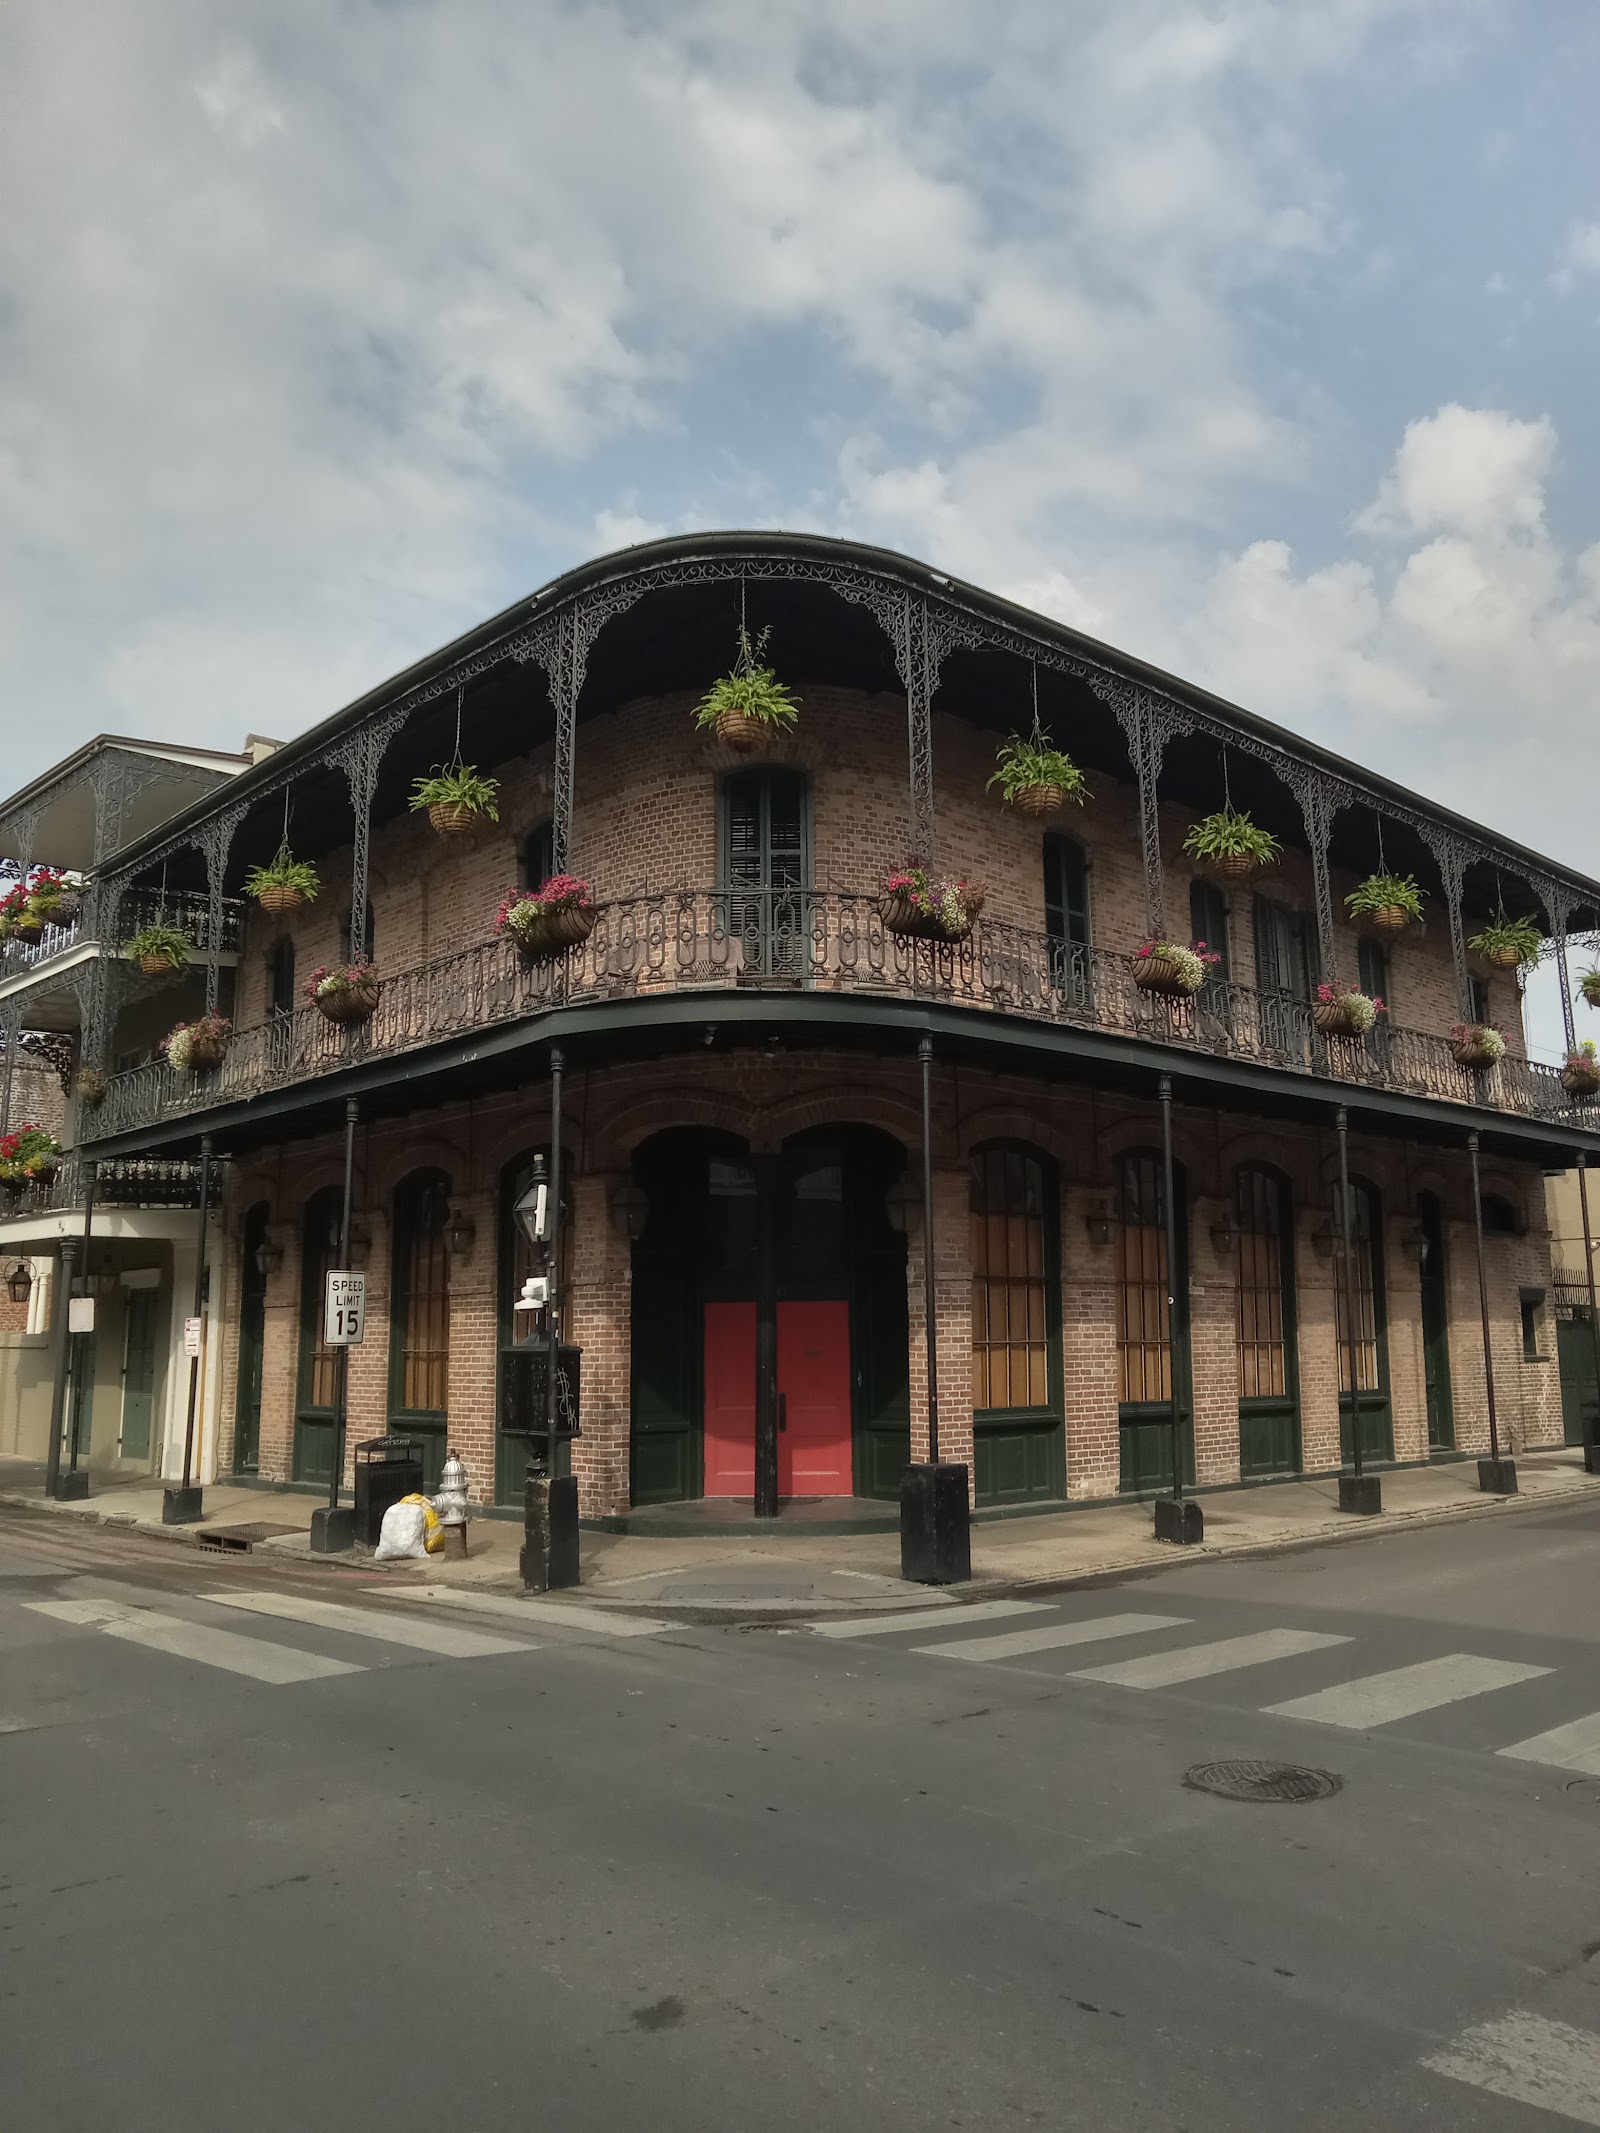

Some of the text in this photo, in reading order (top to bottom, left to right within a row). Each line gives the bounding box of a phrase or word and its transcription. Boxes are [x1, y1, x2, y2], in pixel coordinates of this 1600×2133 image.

[332, 1280, 363, 1291] SPEED
[336, 1295, 360, 1306] LIMIT
[336, 1310, 358, 1336] 15
